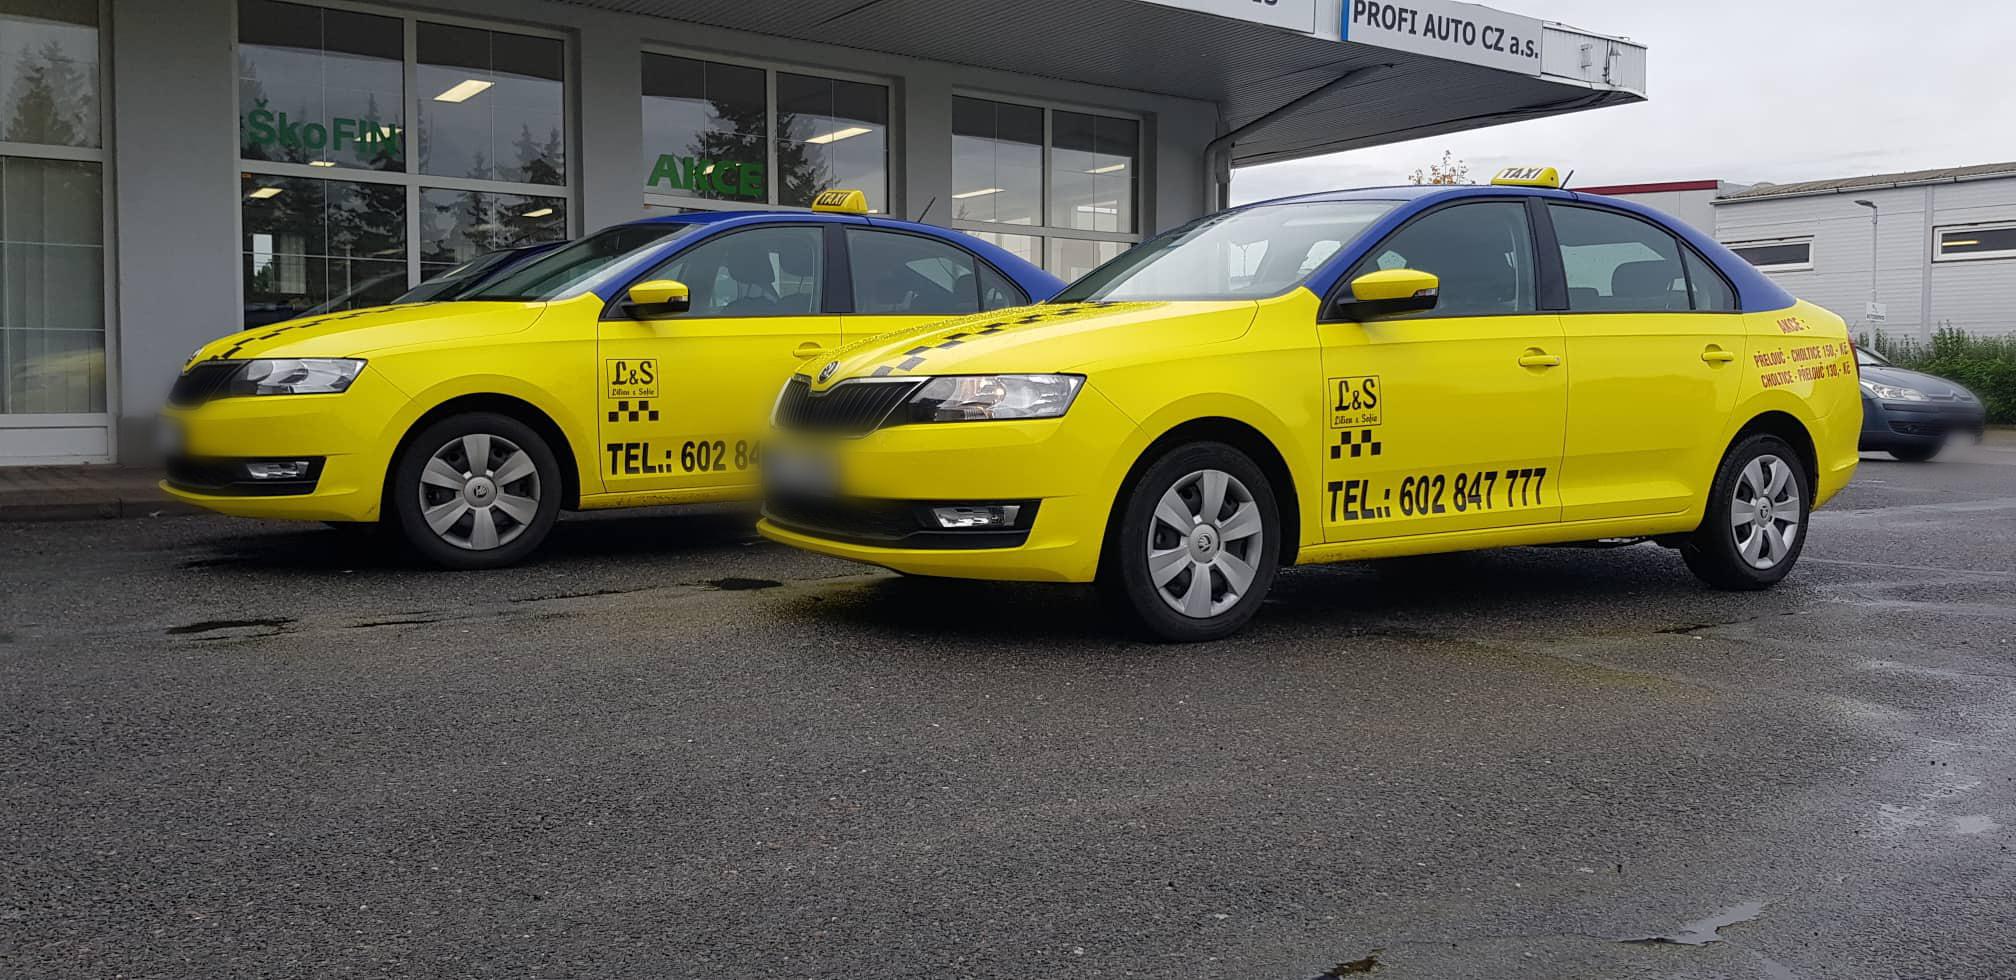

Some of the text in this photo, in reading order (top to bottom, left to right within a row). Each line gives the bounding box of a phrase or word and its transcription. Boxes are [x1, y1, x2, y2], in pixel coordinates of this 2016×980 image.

[1353, 0, 1539, 59] PROFI AUTO CZ a.s.
[646, 153, 765, 197] AKCE
[1503, 167, 1544, 179] TAXI
[820, 192, 850, 206] TAXI
[1790, 345, 1821, 362] CHOLTICE
[612, 360, 654, 385] L&S
[1761, 371, 1794, 388] CHOLTICE
[1335, 378, 1377, 411] L&S
[606, 440, 761, 475] TEL.: 602 84
[1327, 467, 1547, 522] TEL.: 602 847 777
